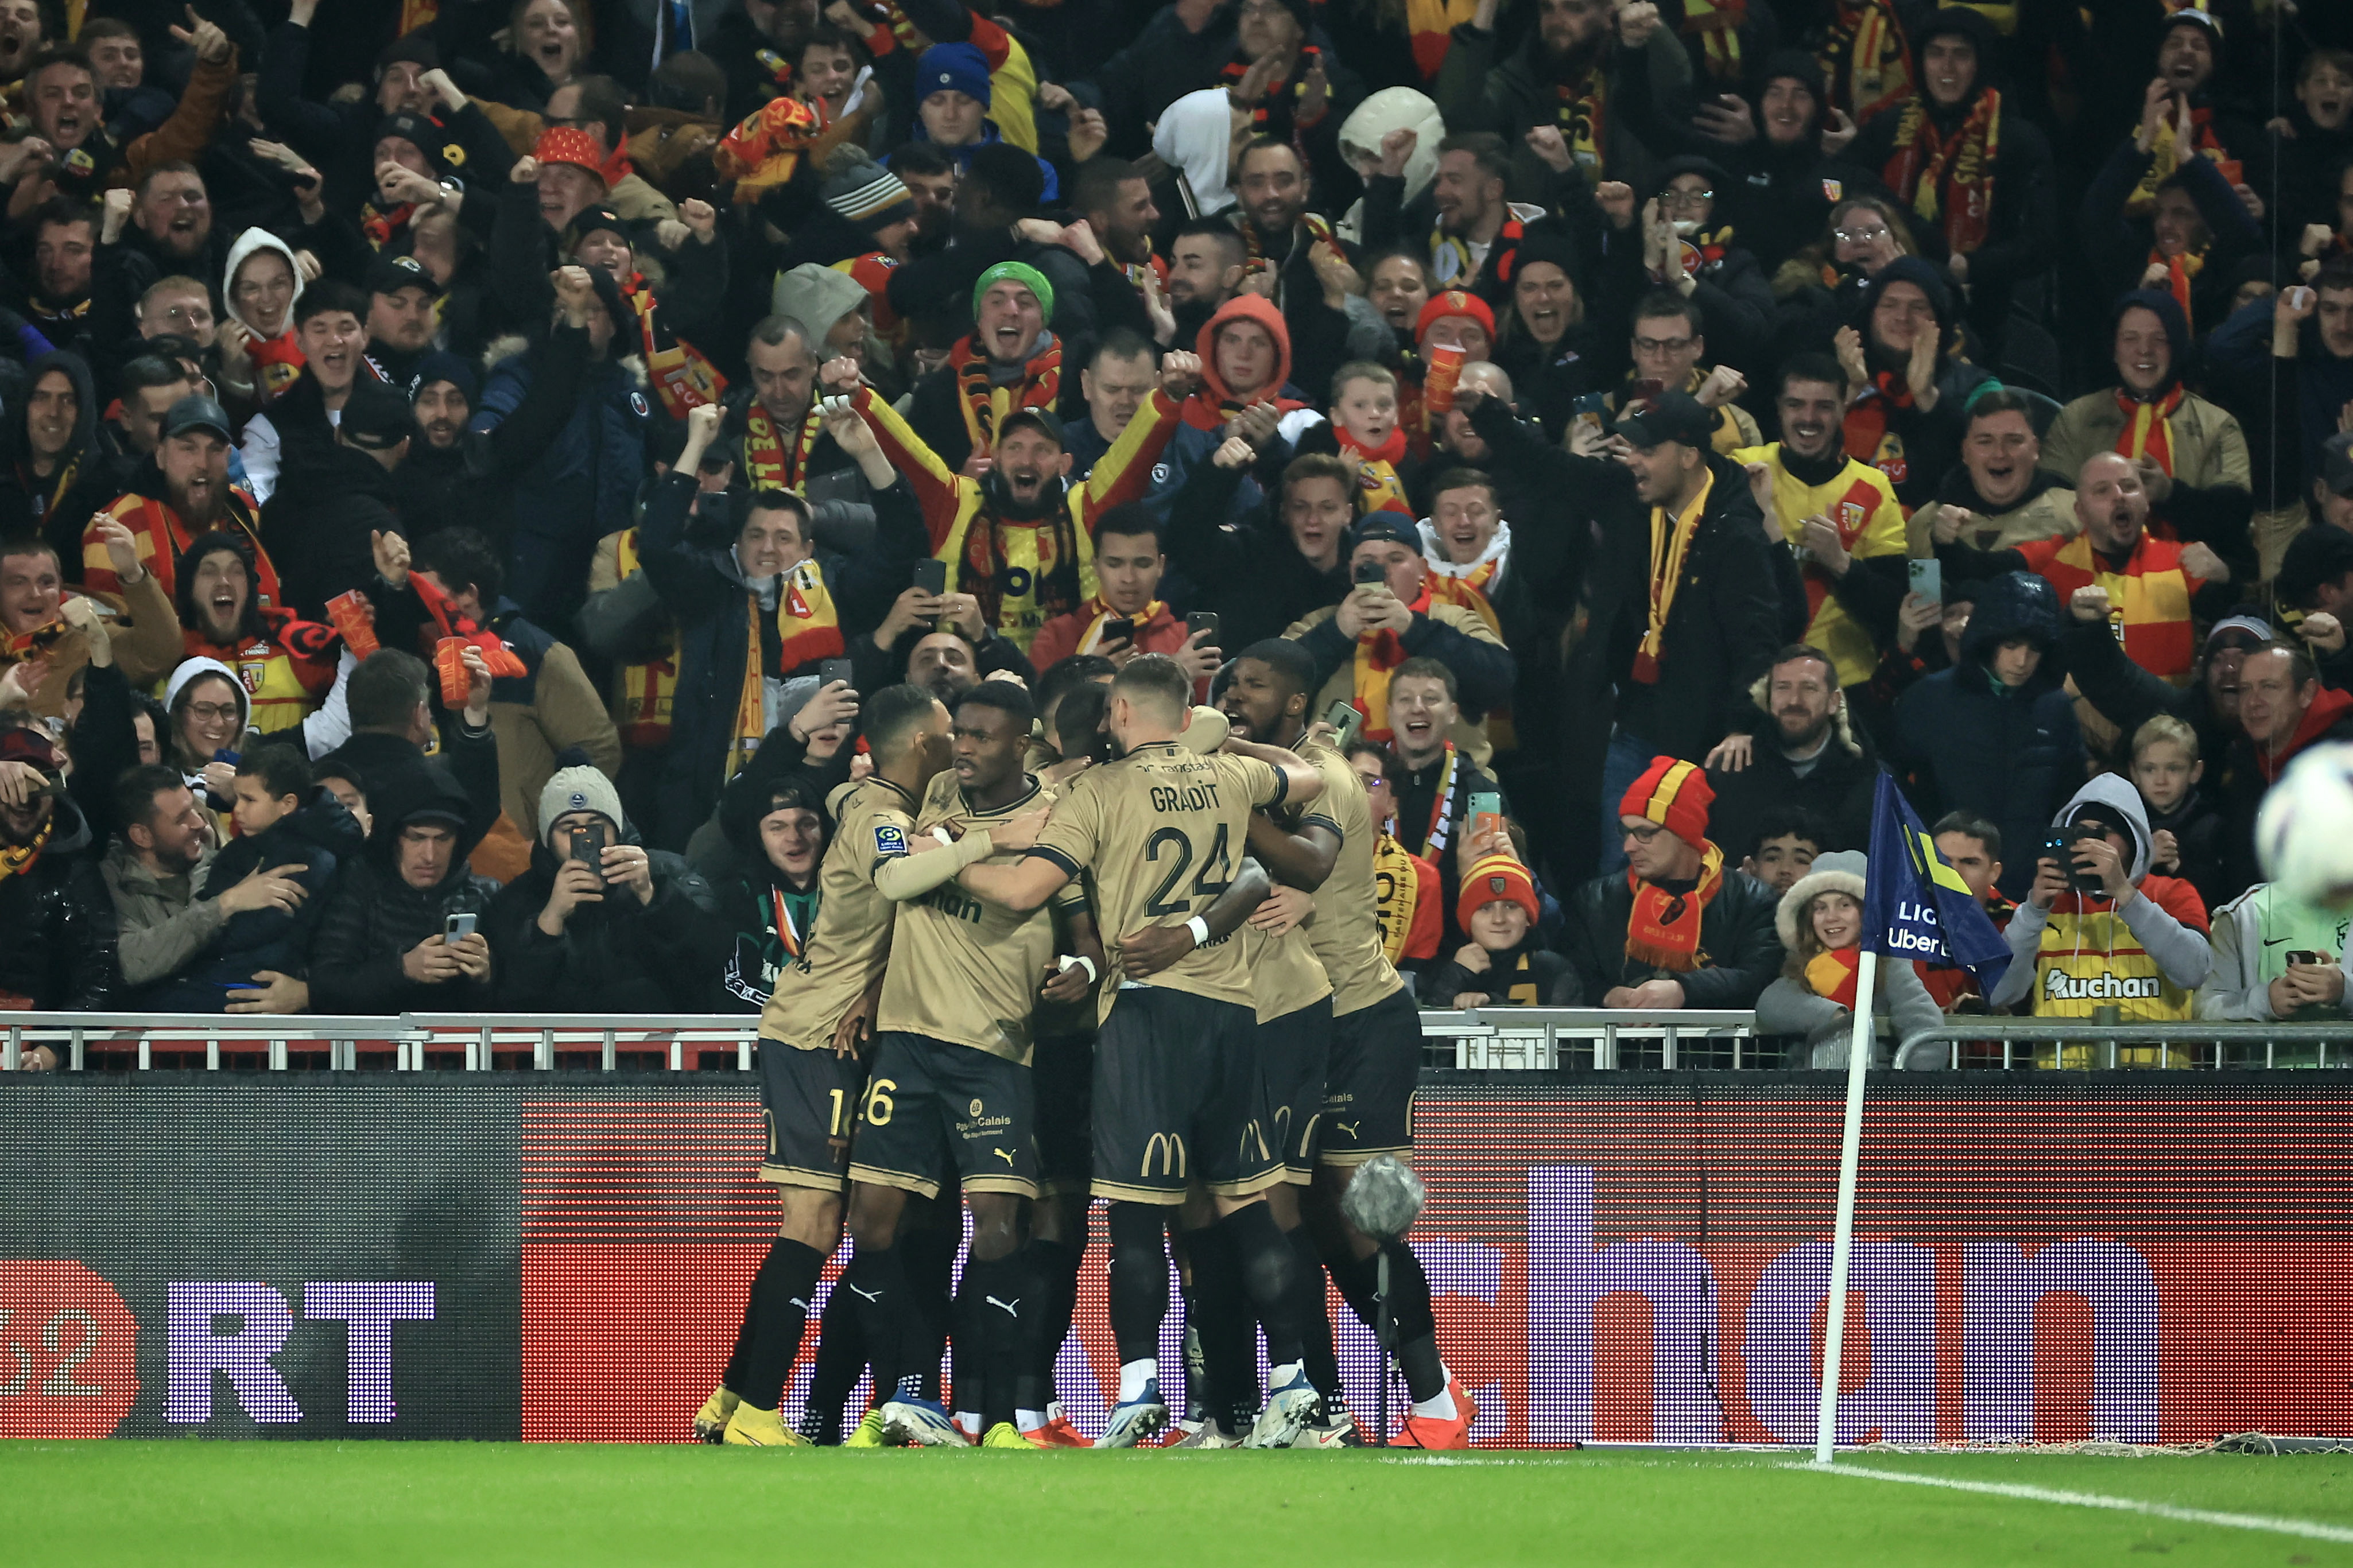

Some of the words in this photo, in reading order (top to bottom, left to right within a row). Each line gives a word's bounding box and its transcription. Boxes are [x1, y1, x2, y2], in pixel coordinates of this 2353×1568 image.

[1144, 823, 1233, 918] 24
[1887, 927, 1939, 953] Uber
[2044, 968, 2160, 1001] Auchan
[162, 1280, 436, 1423] RT
